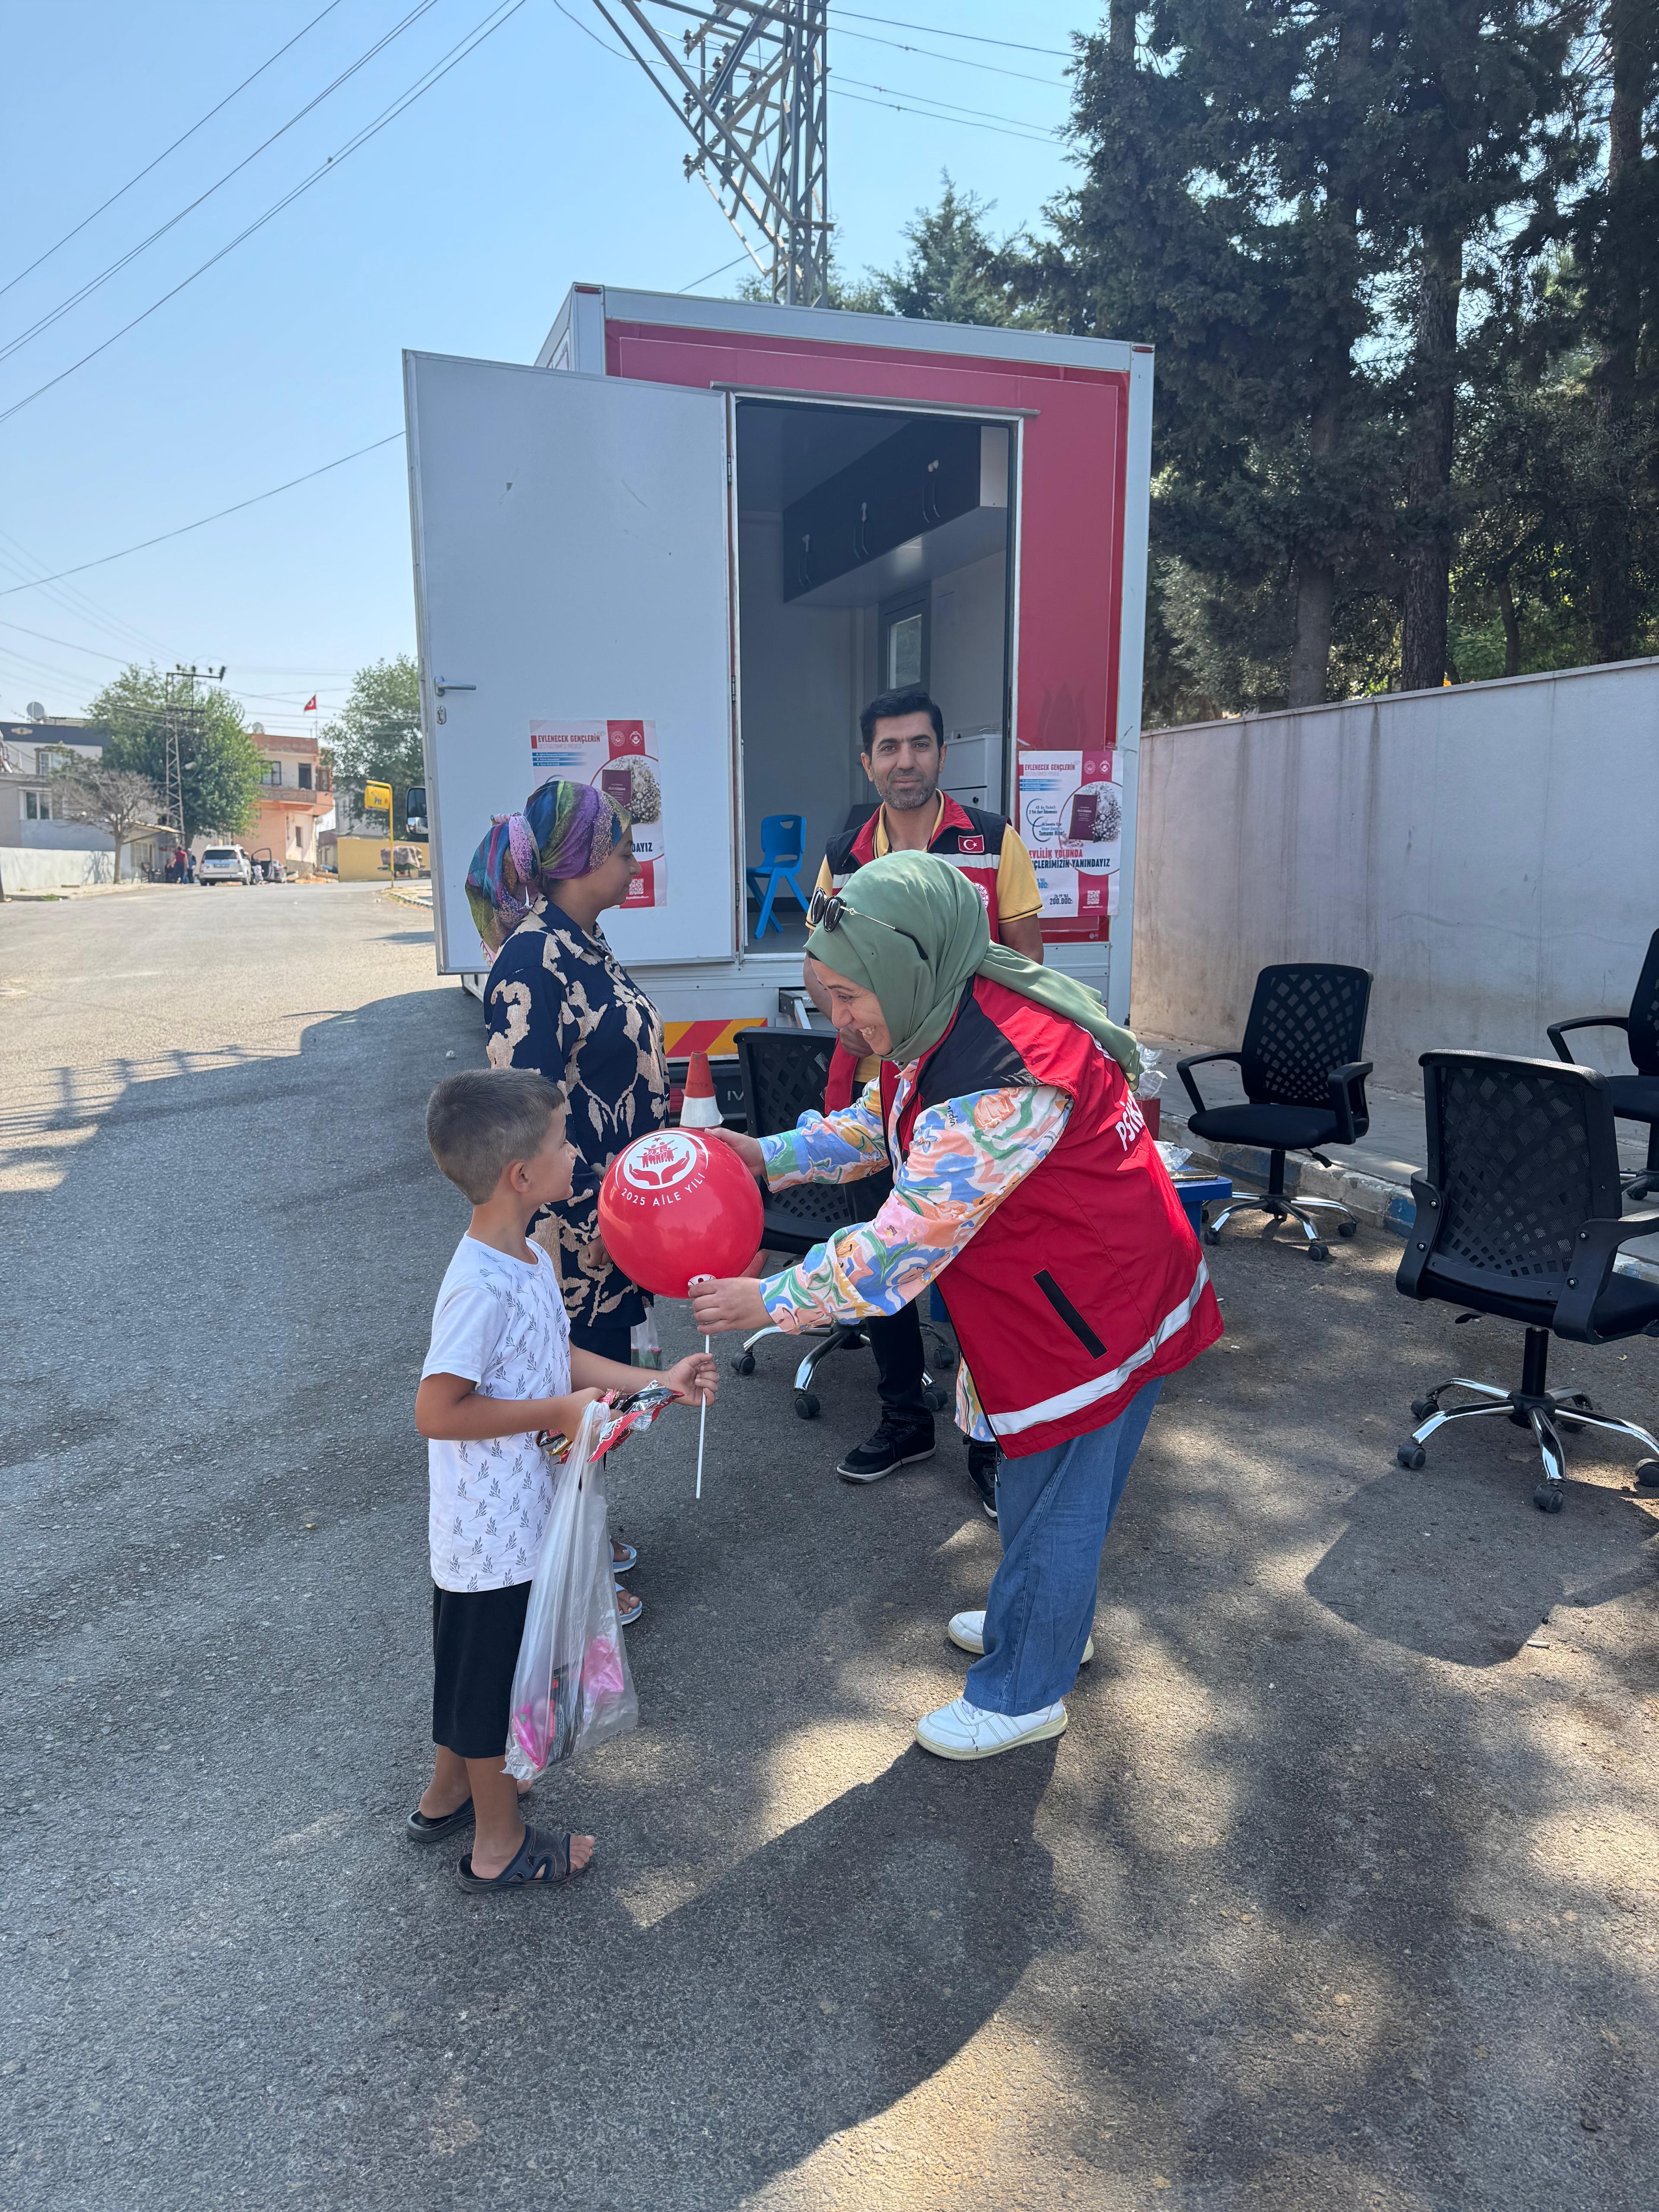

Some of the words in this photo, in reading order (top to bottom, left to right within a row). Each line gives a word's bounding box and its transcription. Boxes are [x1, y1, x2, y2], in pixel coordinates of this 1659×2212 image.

[570, 733, 600, 744] GENÇLERİN
[1050, 763, 1075, 772] GENÇLERİN
[1029, 848, 1052, 859] EVLİLİK
[1054, 849, 1083, 858] YOLUNDA
[1071, 858, 1110, 868] YANINDAYIZ
[621, 1188, 646, 1206] 2025
[684, 1173, 705, 1193] YILI
